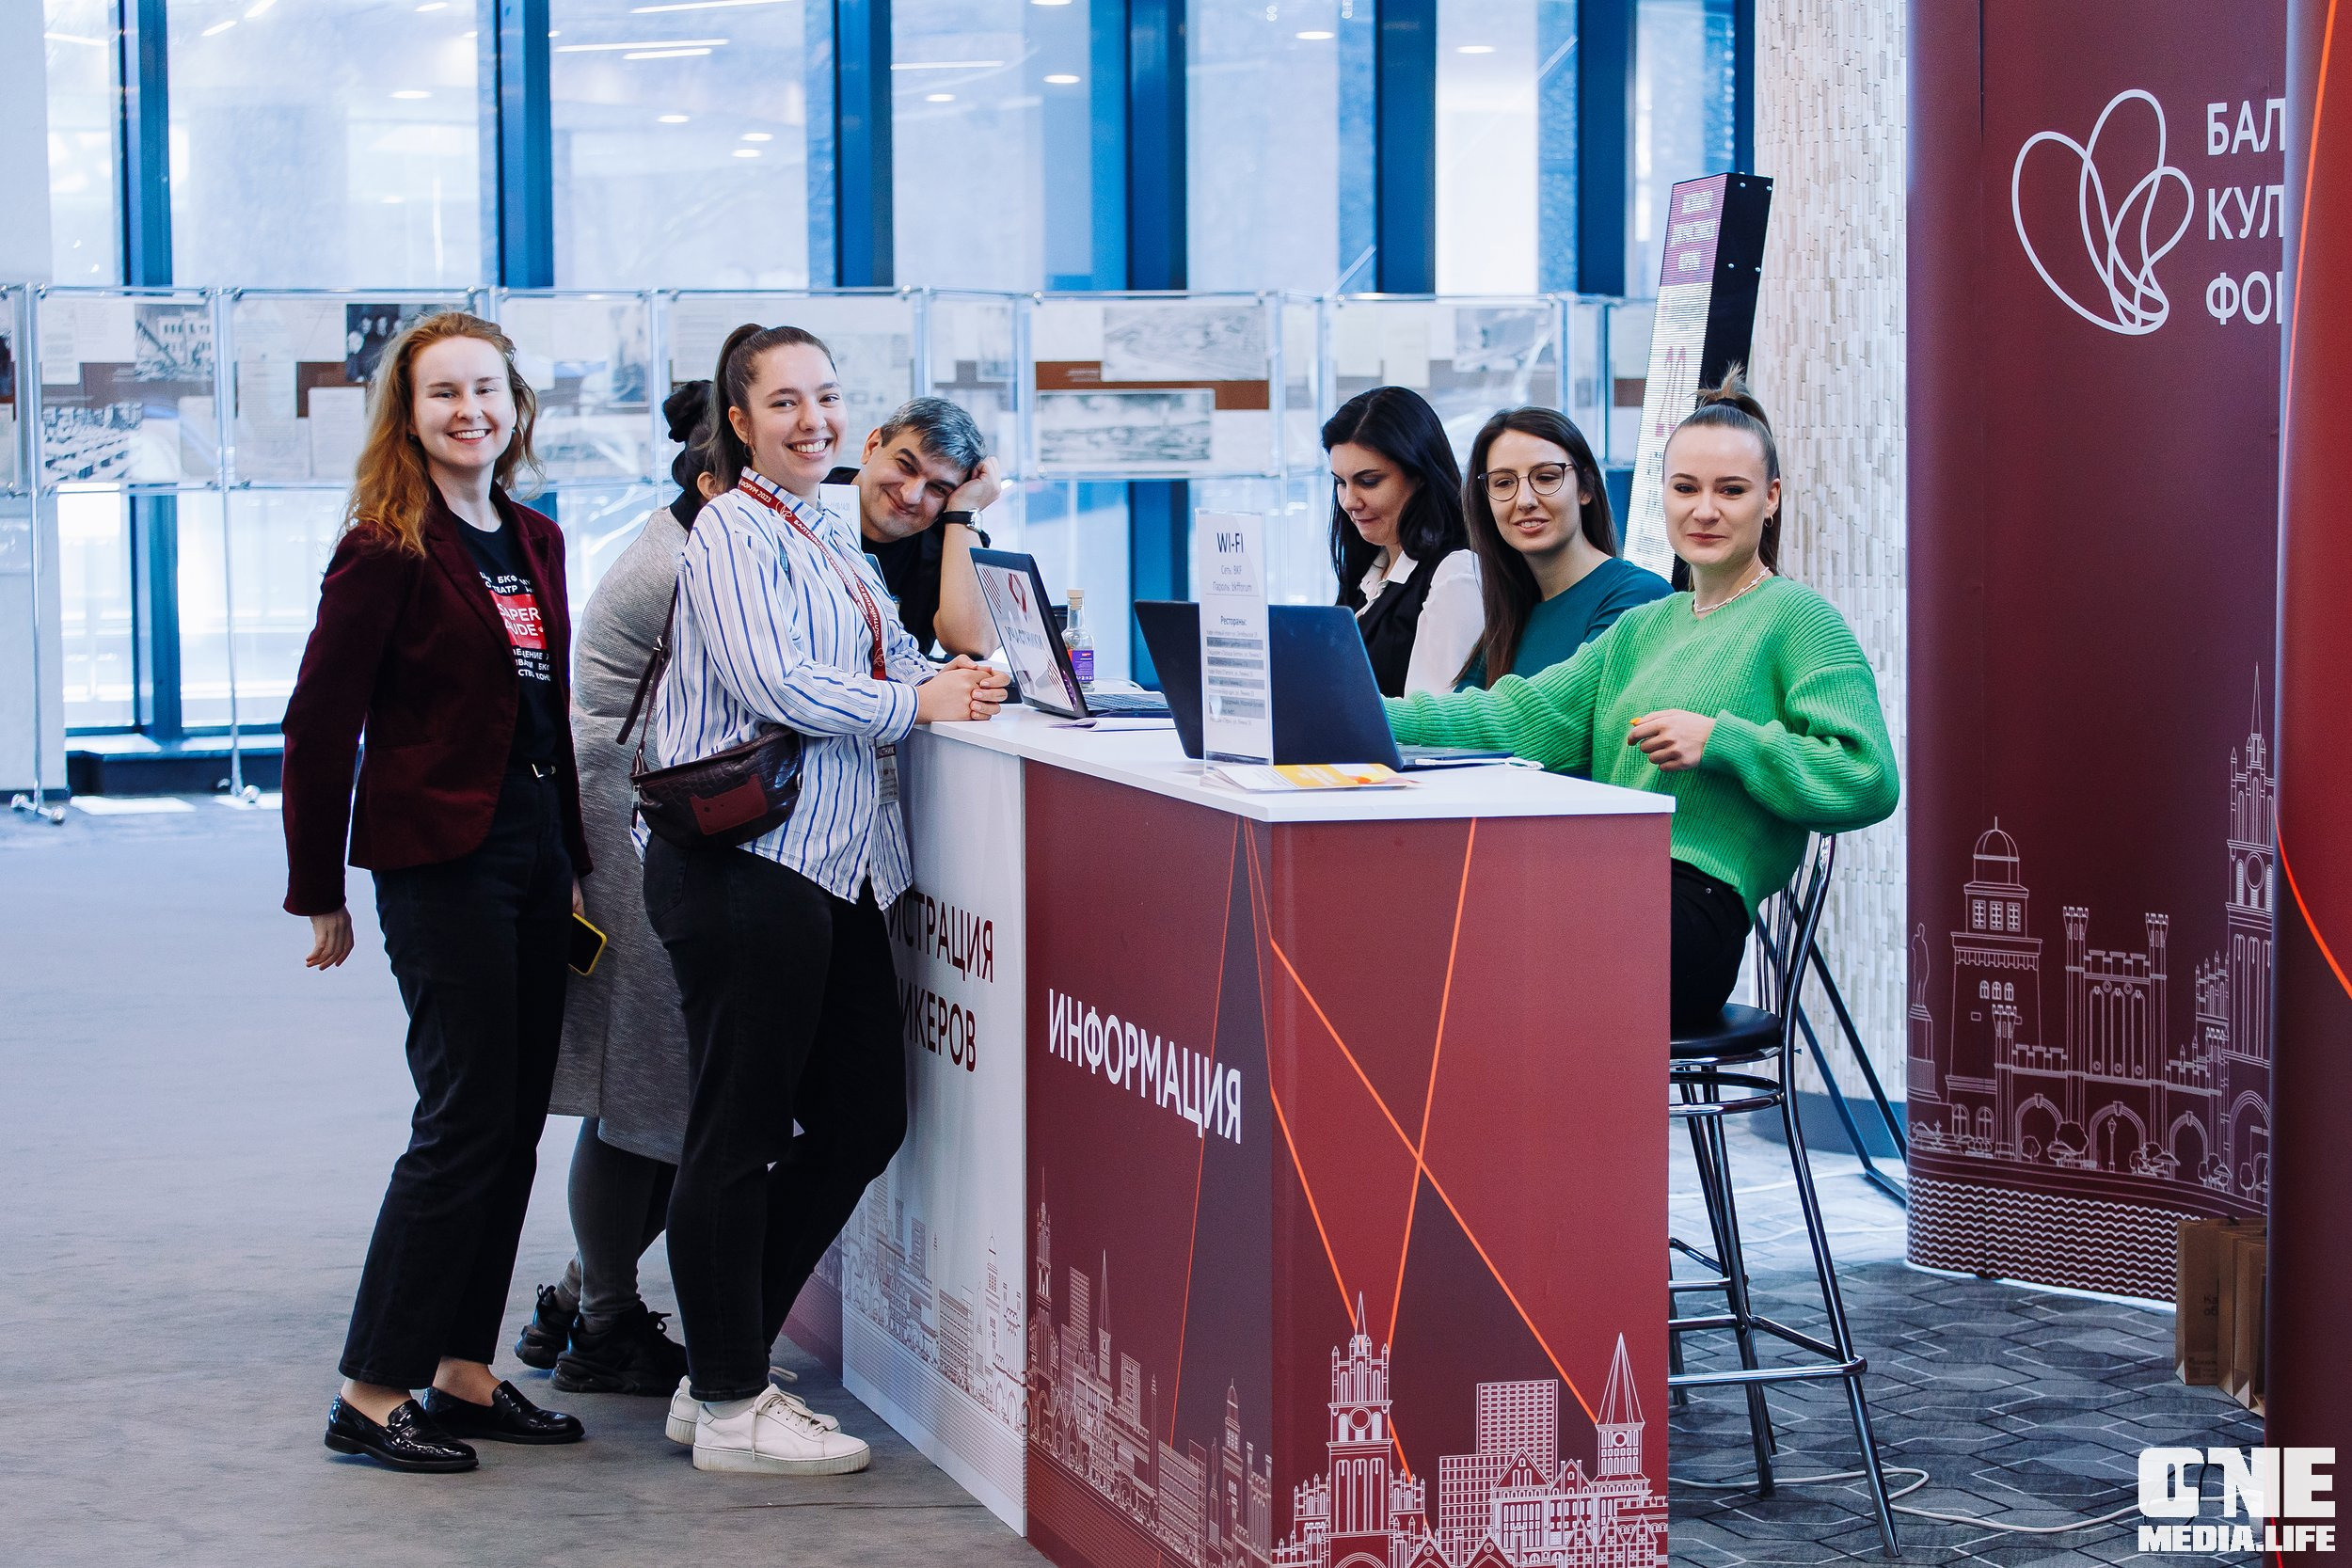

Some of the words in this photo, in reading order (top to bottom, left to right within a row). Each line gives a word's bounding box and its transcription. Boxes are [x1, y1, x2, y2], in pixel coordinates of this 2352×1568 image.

[2207, 98, 2286, 155] БАЛ
[2207, 185, 2284, 241] КУЛ
[756, 491, 772, 503] 2023
[793, 518, 832, 559] БАЛТИЙСКИЙ
[1216, 532, 1244, 553] WI-FI
[497, 575, 517, 584] БКФ
[497, 603, 541, 622] SAPER
[1049, 988, 1241, 1145] ИНФОРМАЦИЯ
